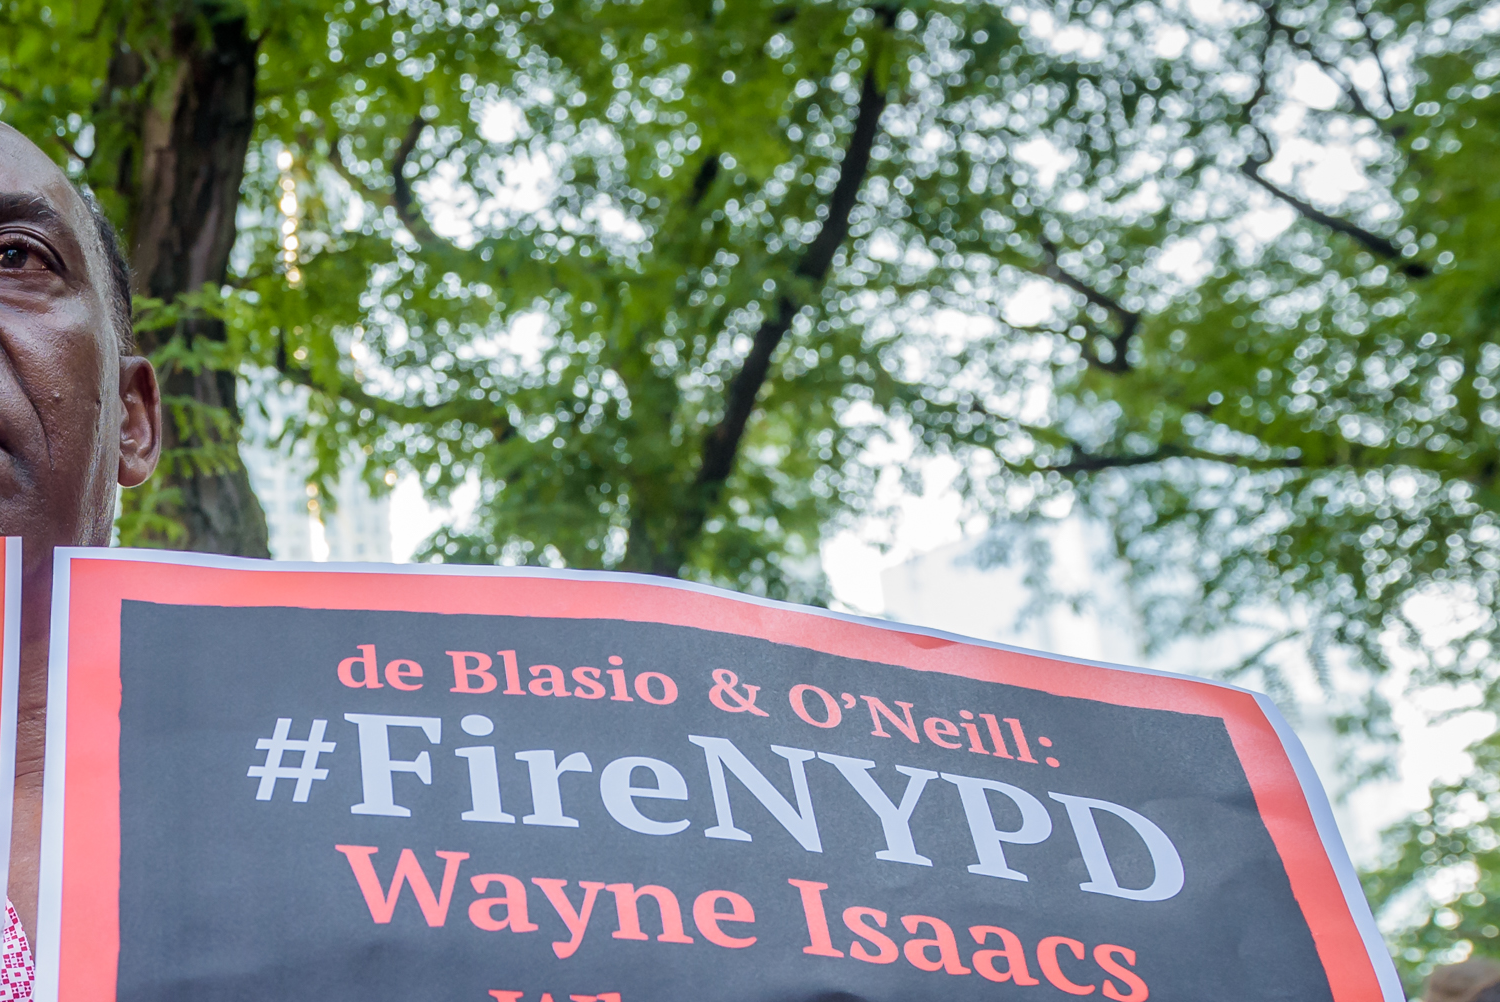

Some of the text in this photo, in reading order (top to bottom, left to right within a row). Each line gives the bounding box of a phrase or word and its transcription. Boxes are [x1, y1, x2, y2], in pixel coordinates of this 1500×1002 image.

[336, 643, 425, 692] de
[445, 648, 679, 706] Blasio
[708, 667, 770, 718] &
[246, 711, 1186, 902] #FireNYPD
[334, 844, 759, 959] Wayne
